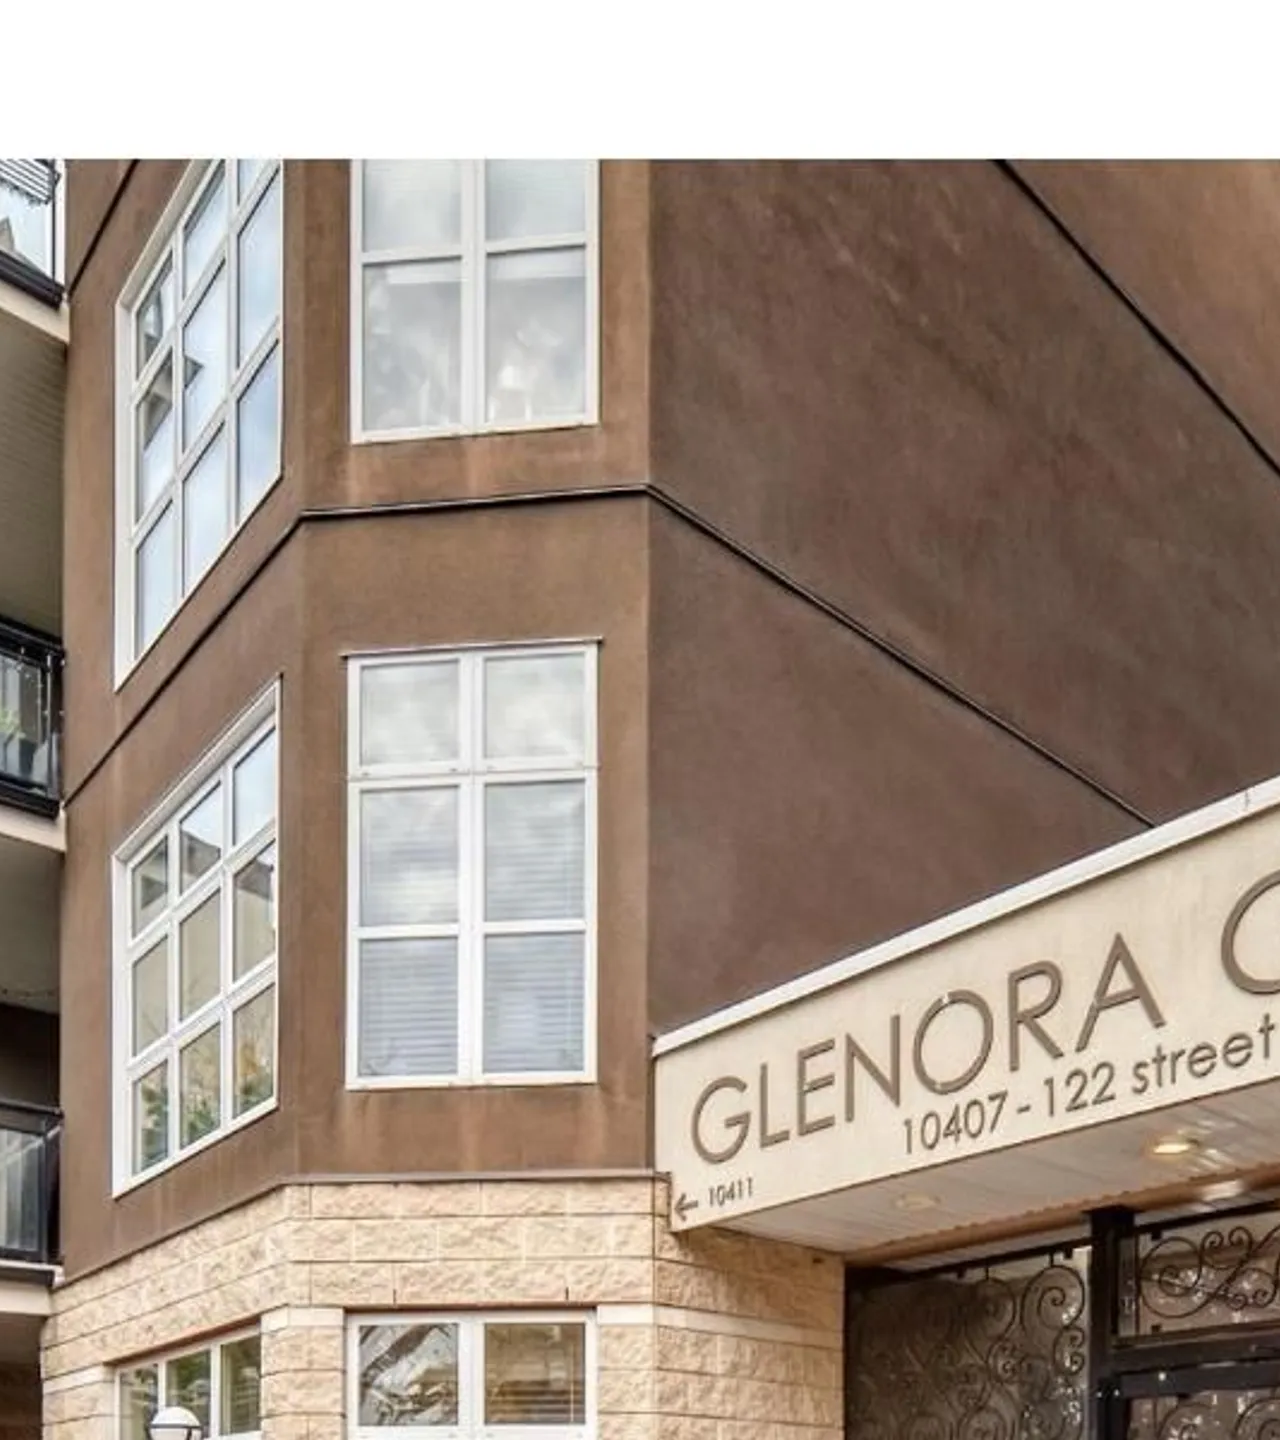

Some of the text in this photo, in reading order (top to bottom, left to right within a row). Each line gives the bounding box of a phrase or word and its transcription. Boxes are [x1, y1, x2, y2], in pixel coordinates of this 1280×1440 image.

[691, 932, 1167, 1165] GLENORA
[1131, 1012, 1276, 1095] street
[707, 1176, 754, 1209] 10411
